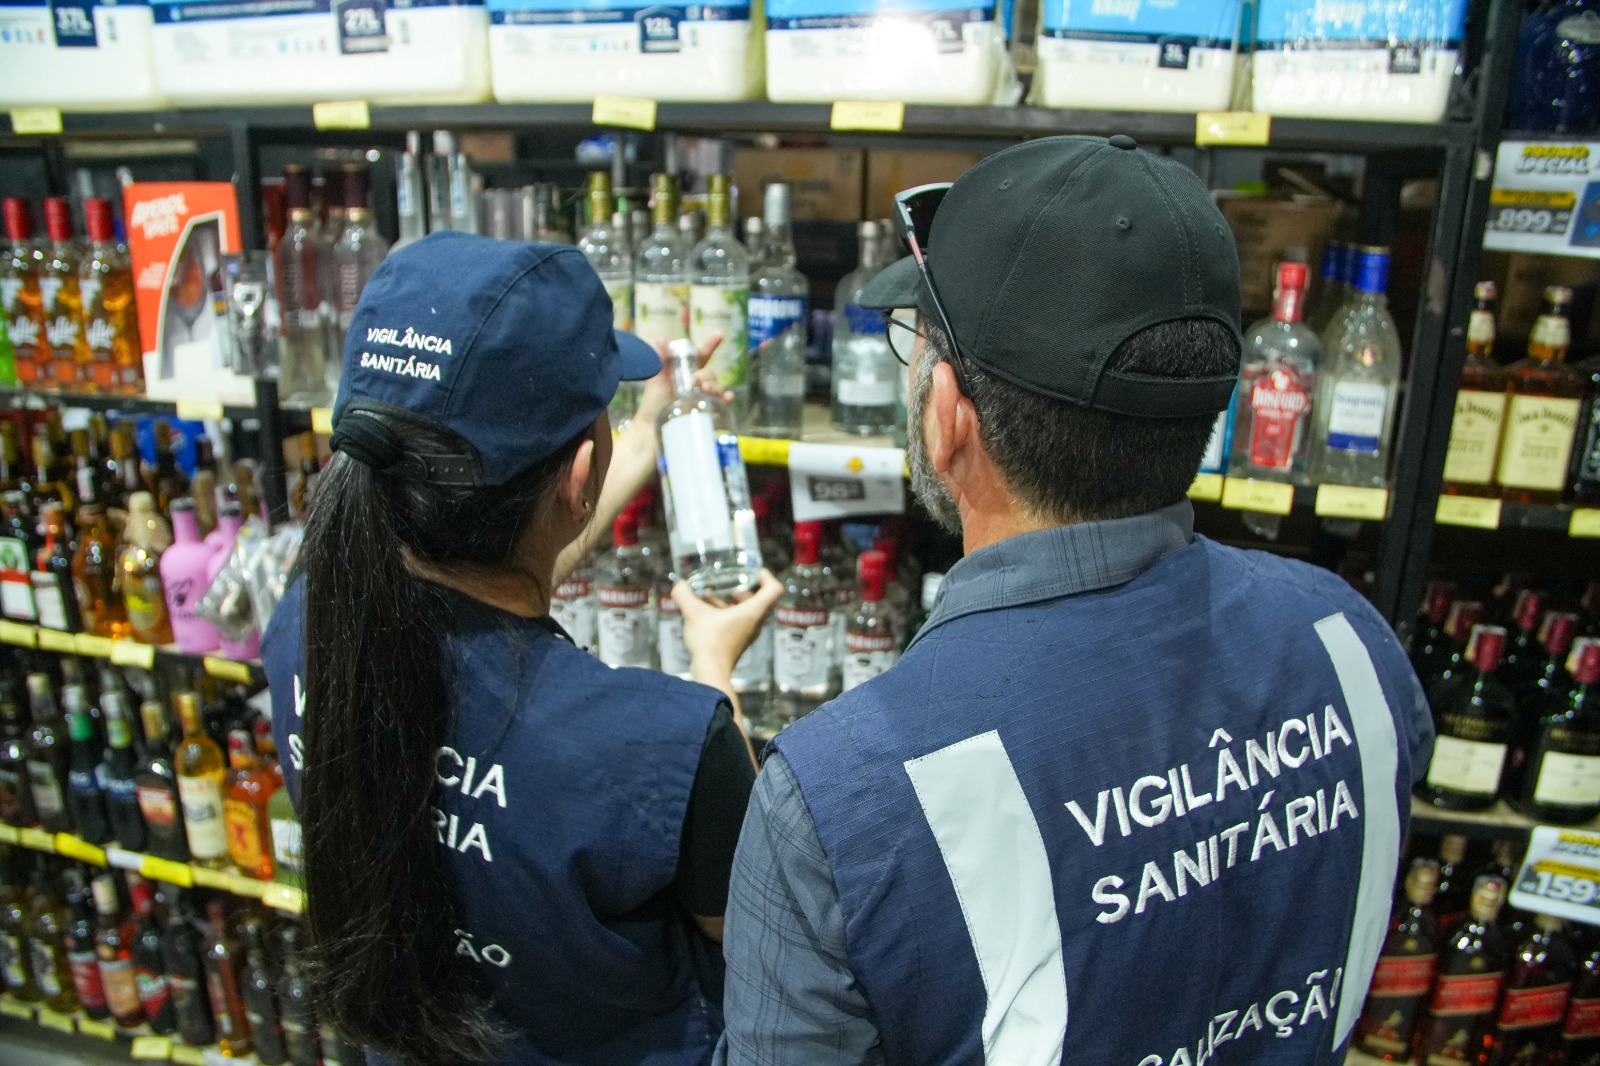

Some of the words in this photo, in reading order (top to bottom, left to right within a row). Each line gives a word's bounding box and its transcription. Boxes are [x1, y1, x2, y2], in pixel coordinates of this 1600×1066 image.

[366, 326, 452, 355] VIGILÂNCIA
[360, 352, 441, 381] SANITÁRIA
[1064, 704, 1353, 846] VIGILÂNCIA
[1091, 780, 1360, 924] SANITÁRIA
[1536, 871, 1597, 904] 159
